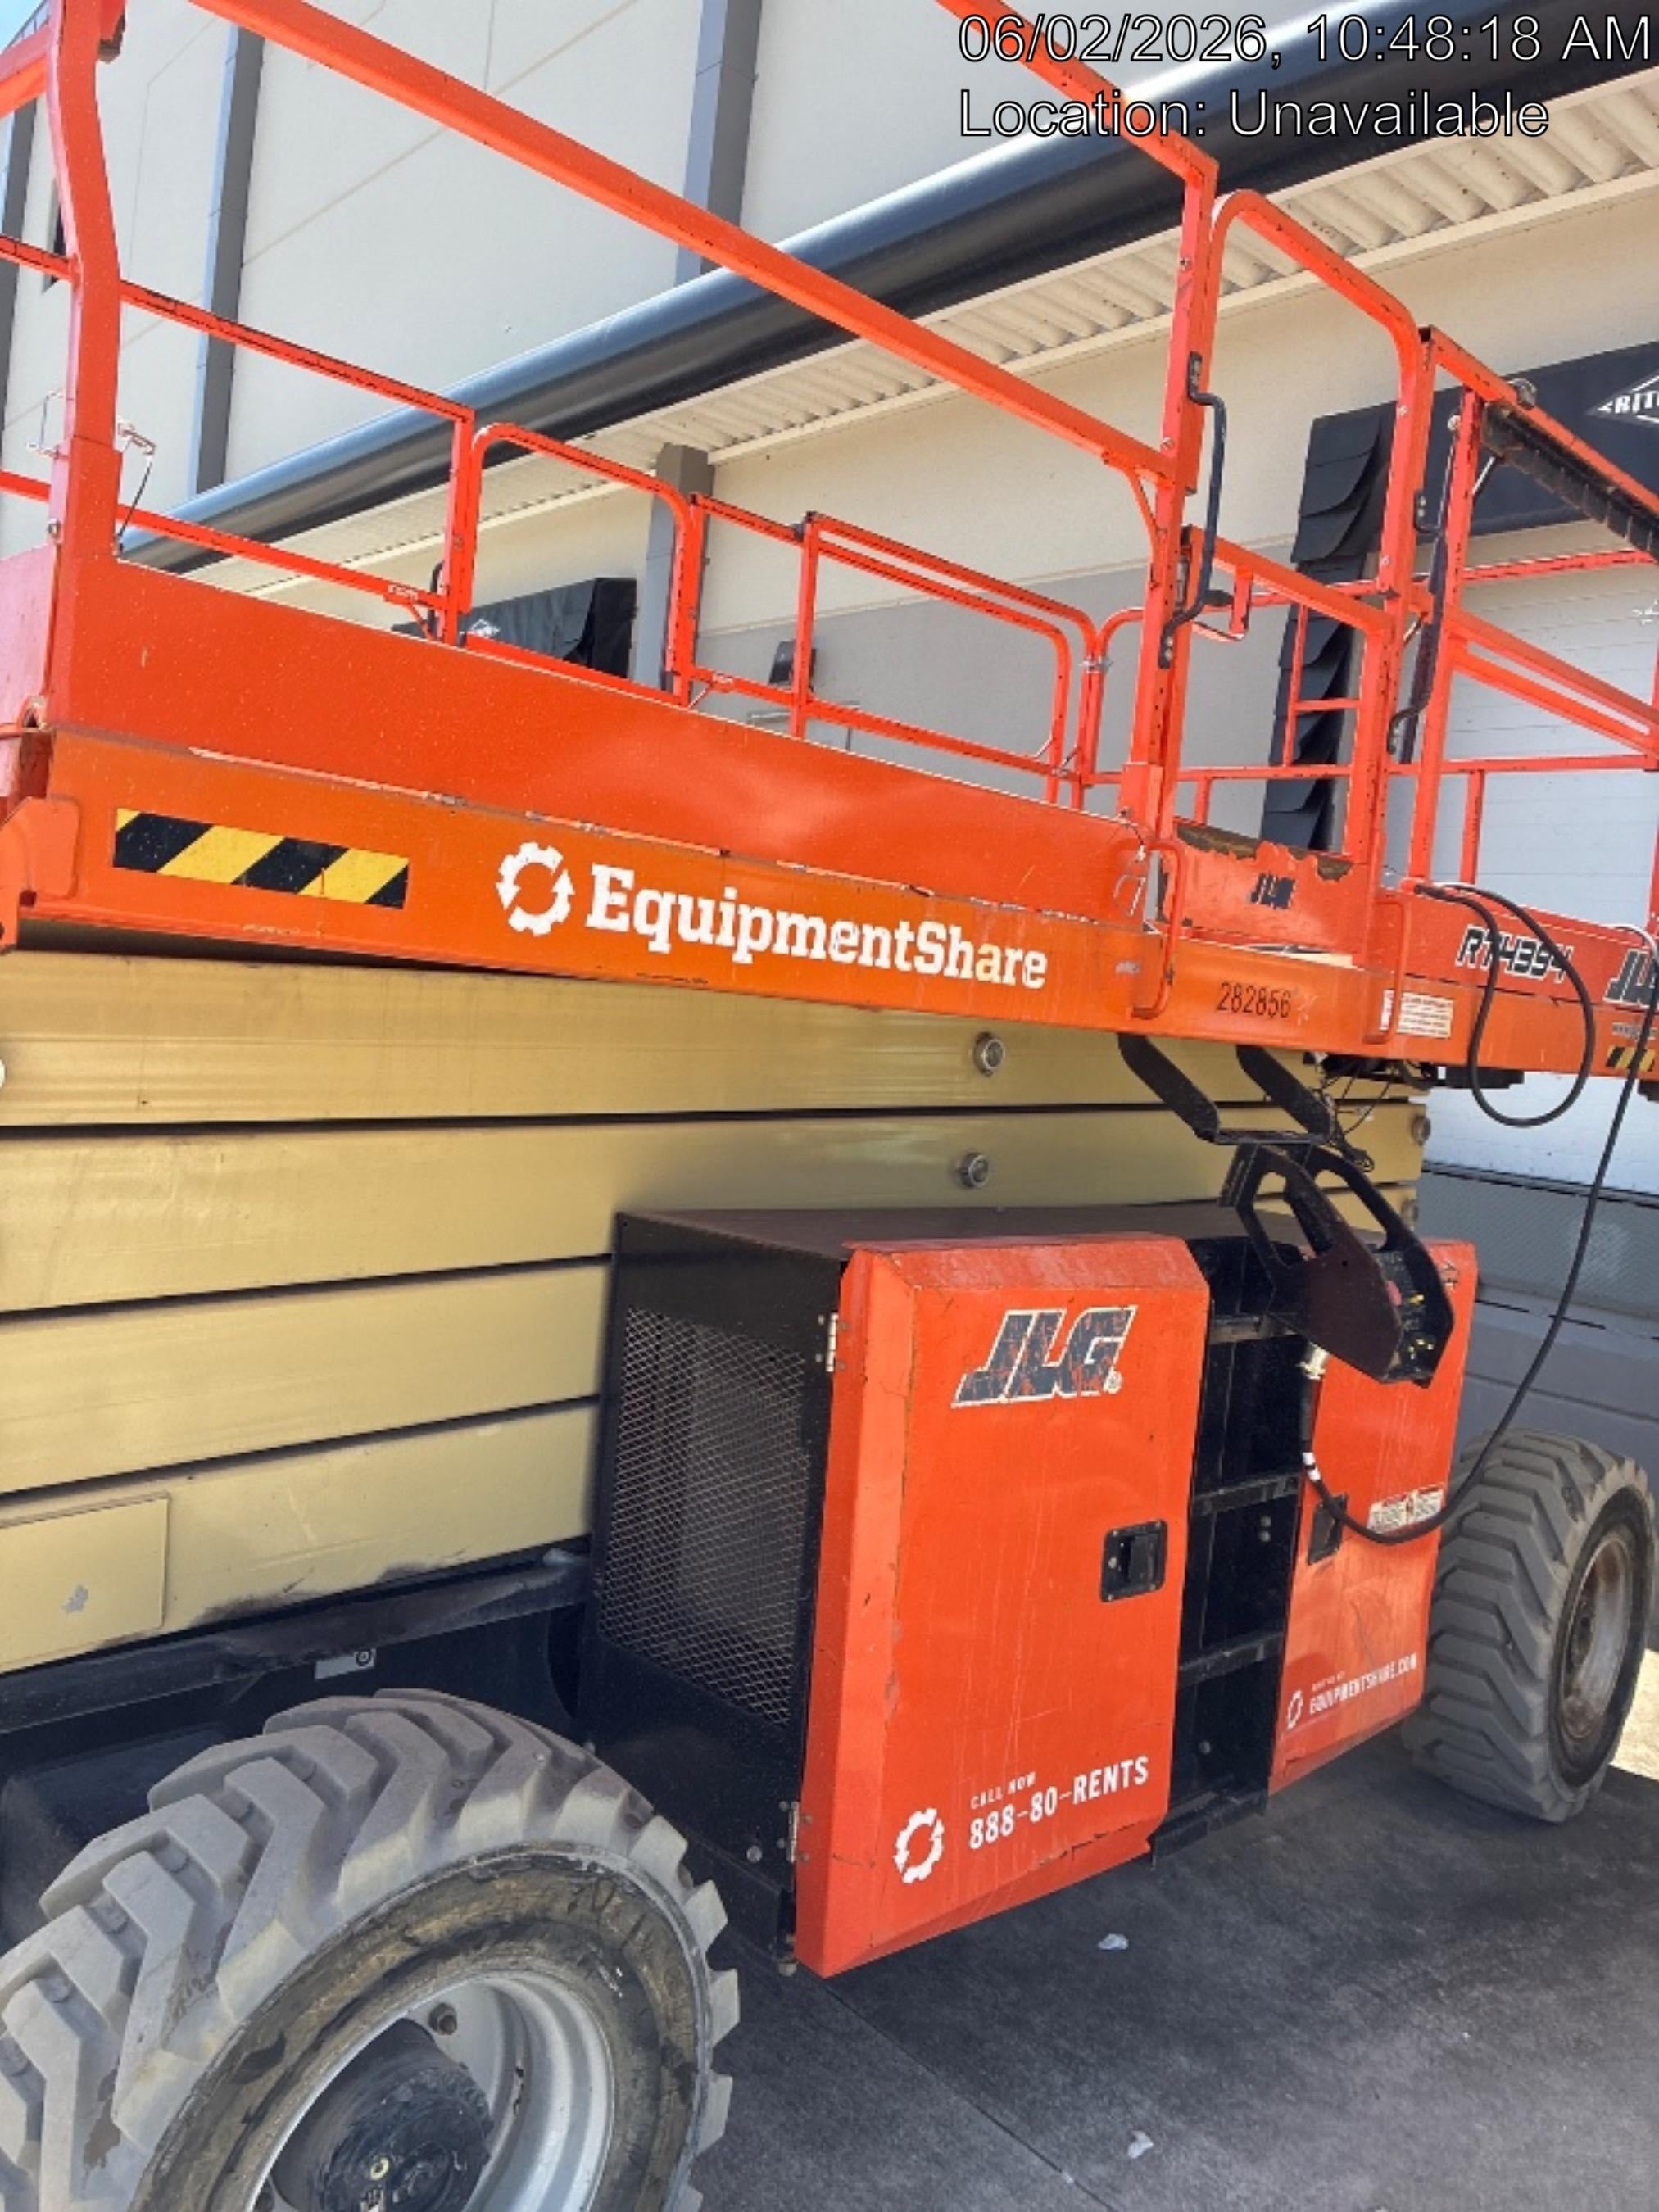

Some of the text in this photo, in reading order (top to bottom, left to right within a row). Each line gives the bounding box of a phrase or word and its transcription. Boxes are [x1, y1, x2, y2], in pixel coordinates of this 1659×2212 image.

[587, 864, 1049, 990] EquipmentShare
[1217, 981, 1291, 1018] 282856
[969, 1756, 1149, 1849] 888-80-RENTS
[971, 1771, 1036, 1809] CALL NOW
